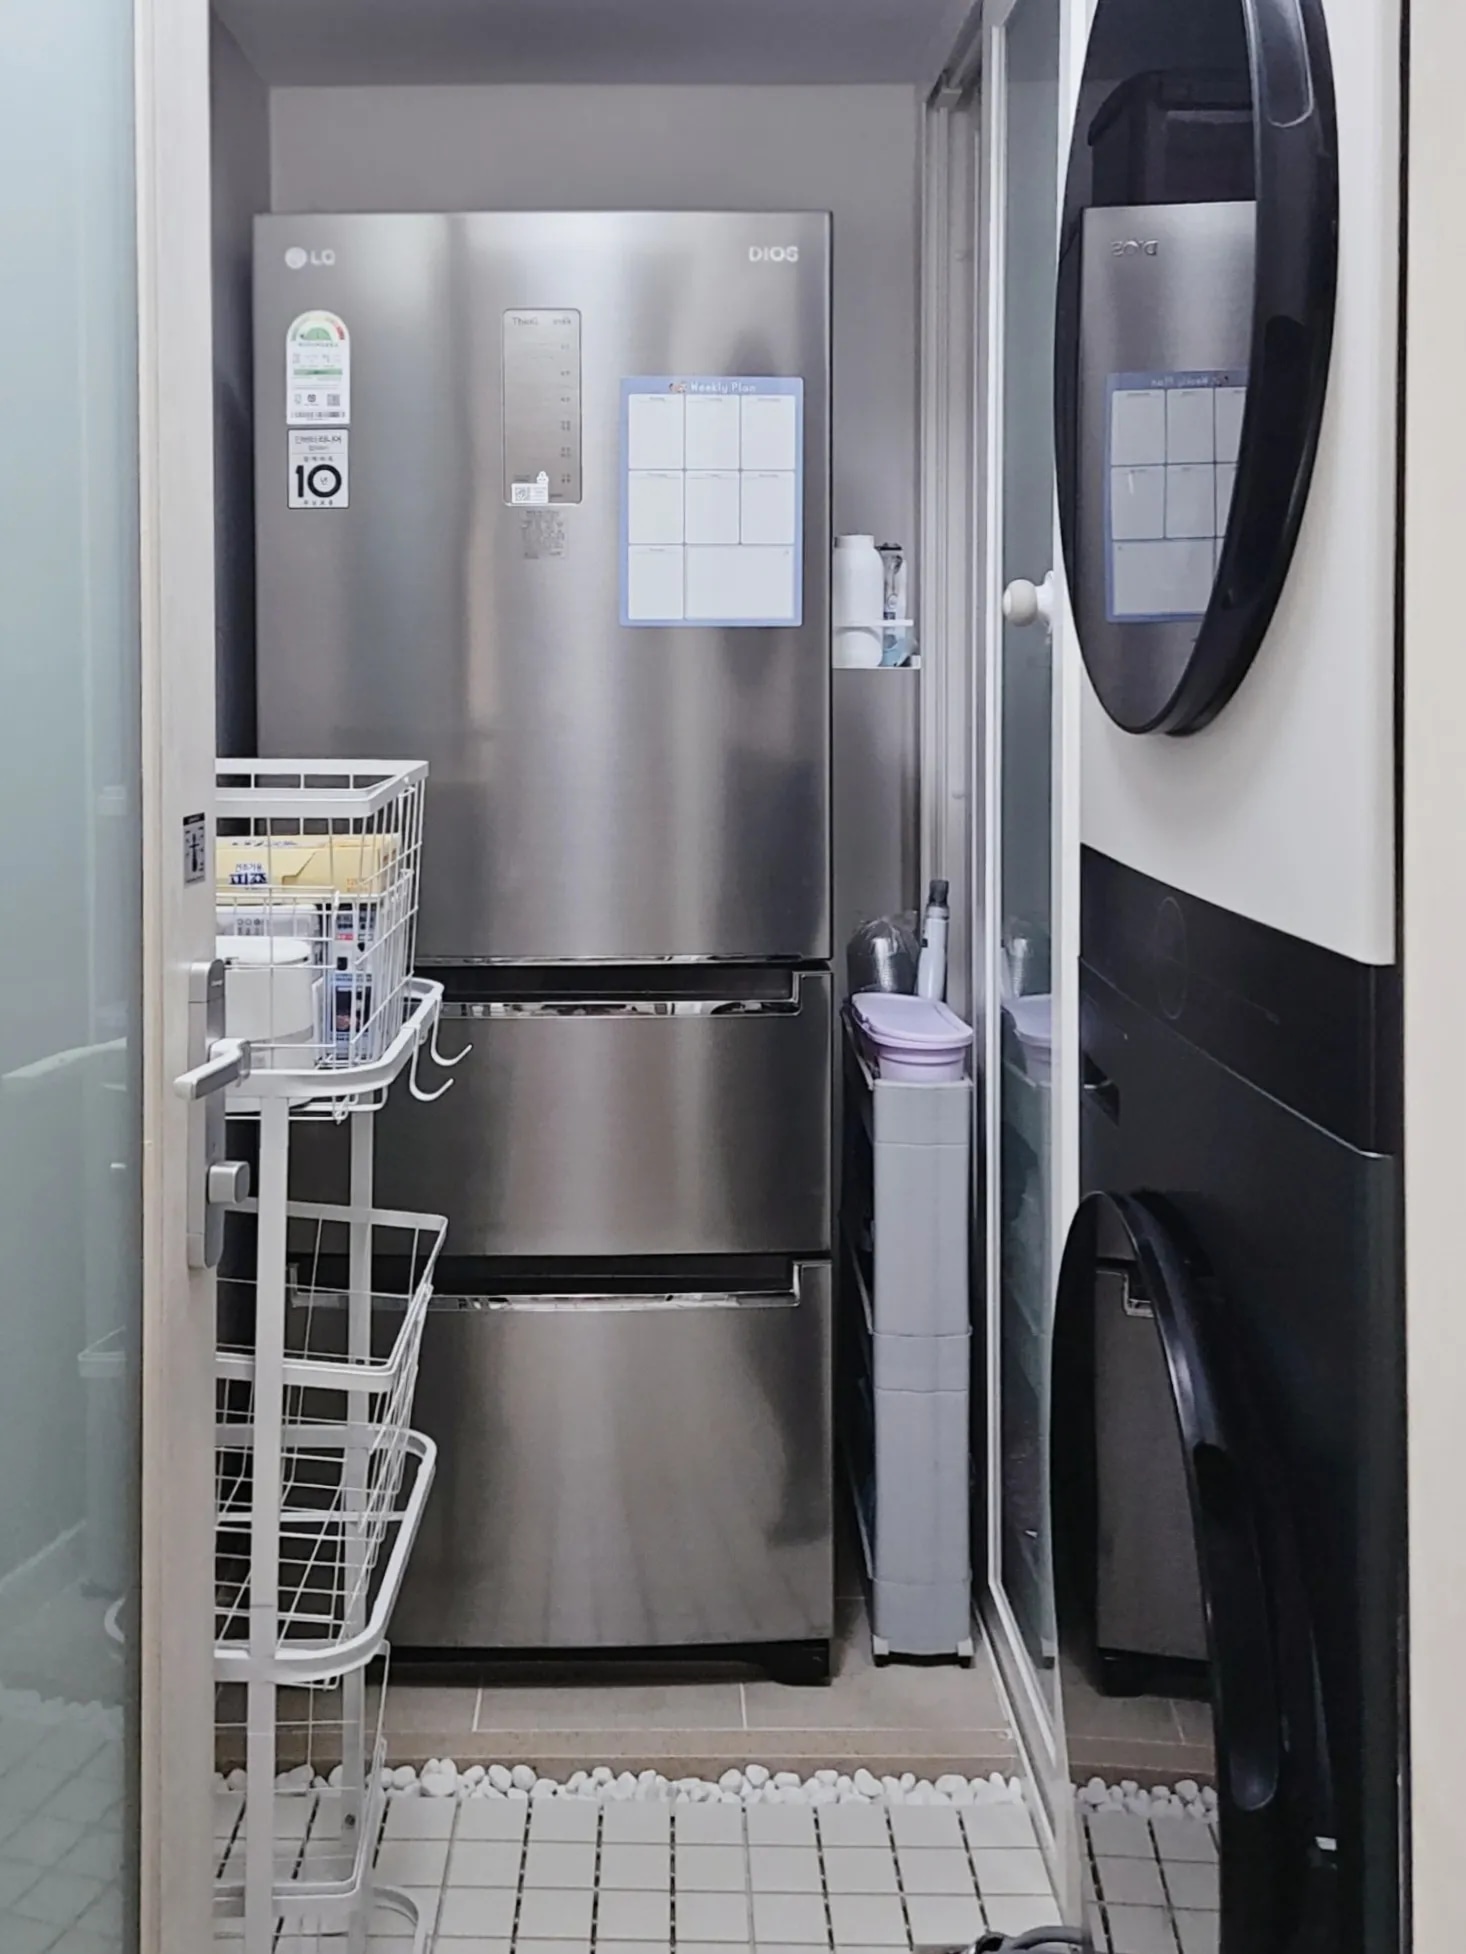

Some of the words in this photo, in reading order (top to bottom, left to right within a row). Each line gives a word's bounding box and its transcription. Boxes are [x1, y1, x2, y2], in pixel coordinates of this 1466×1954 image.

[310, 249, 336, 266] LG
[748, 246, 799, 262] DIOS
[690, 381, 729, 394] Weekly
[731, 380, 757, 393] Plan
[295, 464, 342, 498] 10
